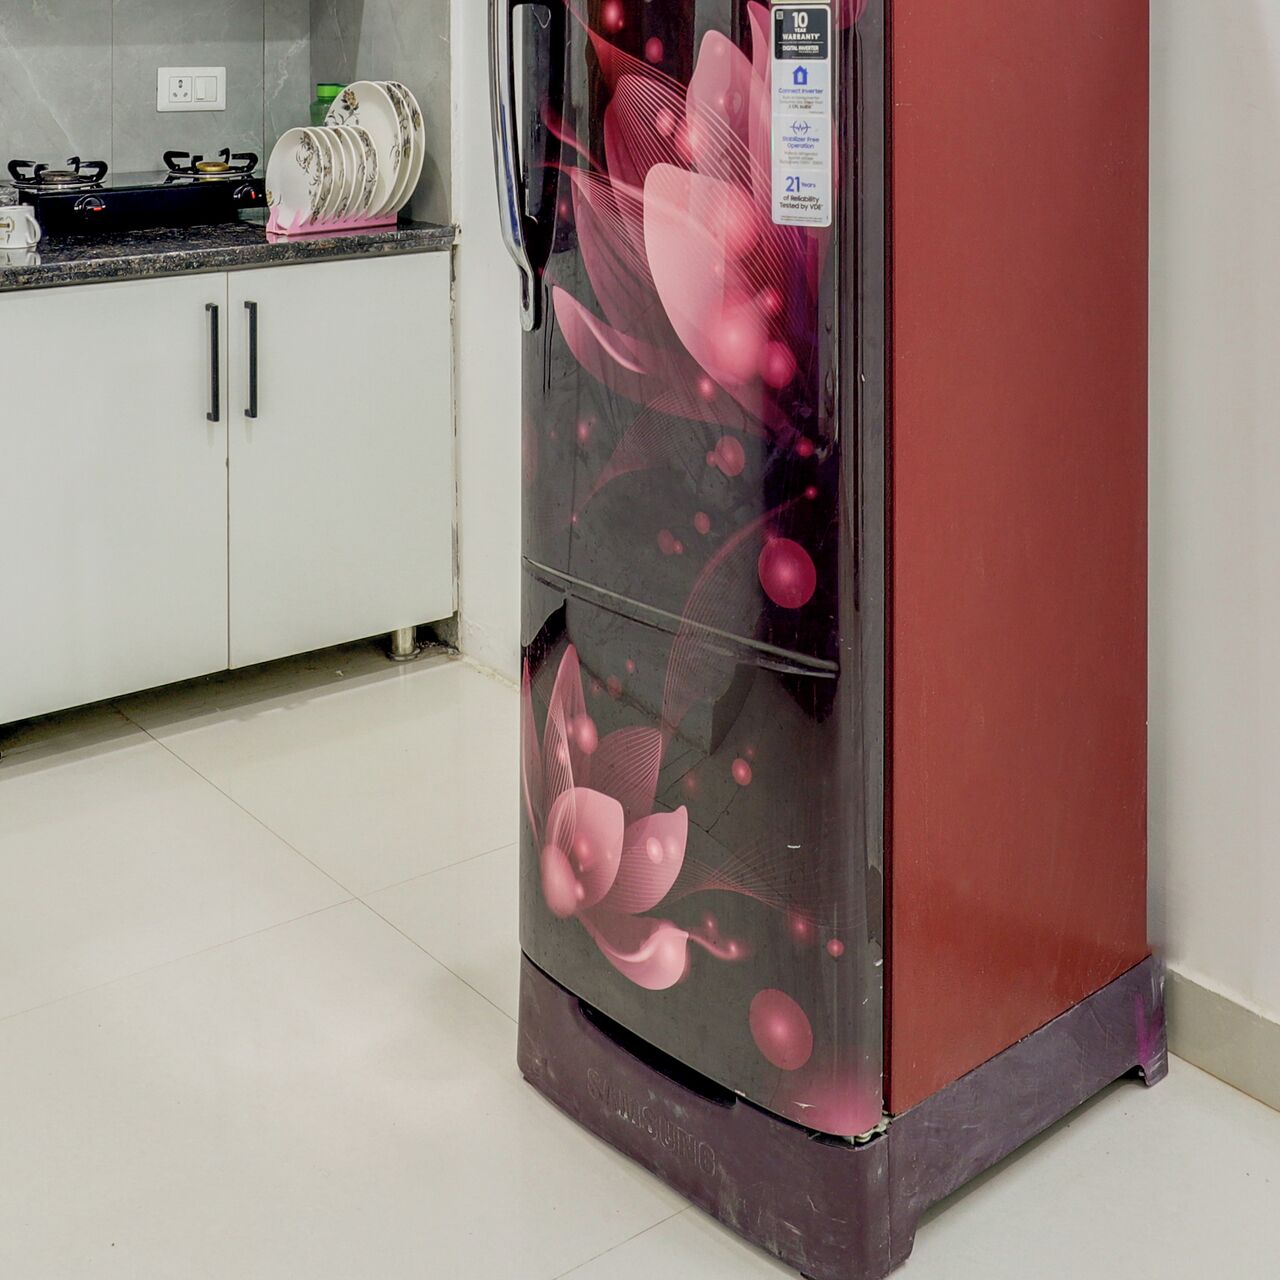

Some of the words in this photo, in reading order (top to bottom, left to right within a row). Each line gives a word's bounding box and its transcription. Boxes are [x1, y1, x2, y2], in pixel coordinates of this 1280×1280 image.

[792, 11, 808, 28] 10
[785, 176, 800, 193] 21
[800, 203, 808, 211] by
[587, 1068, 716, 1177] SAMSUNG
